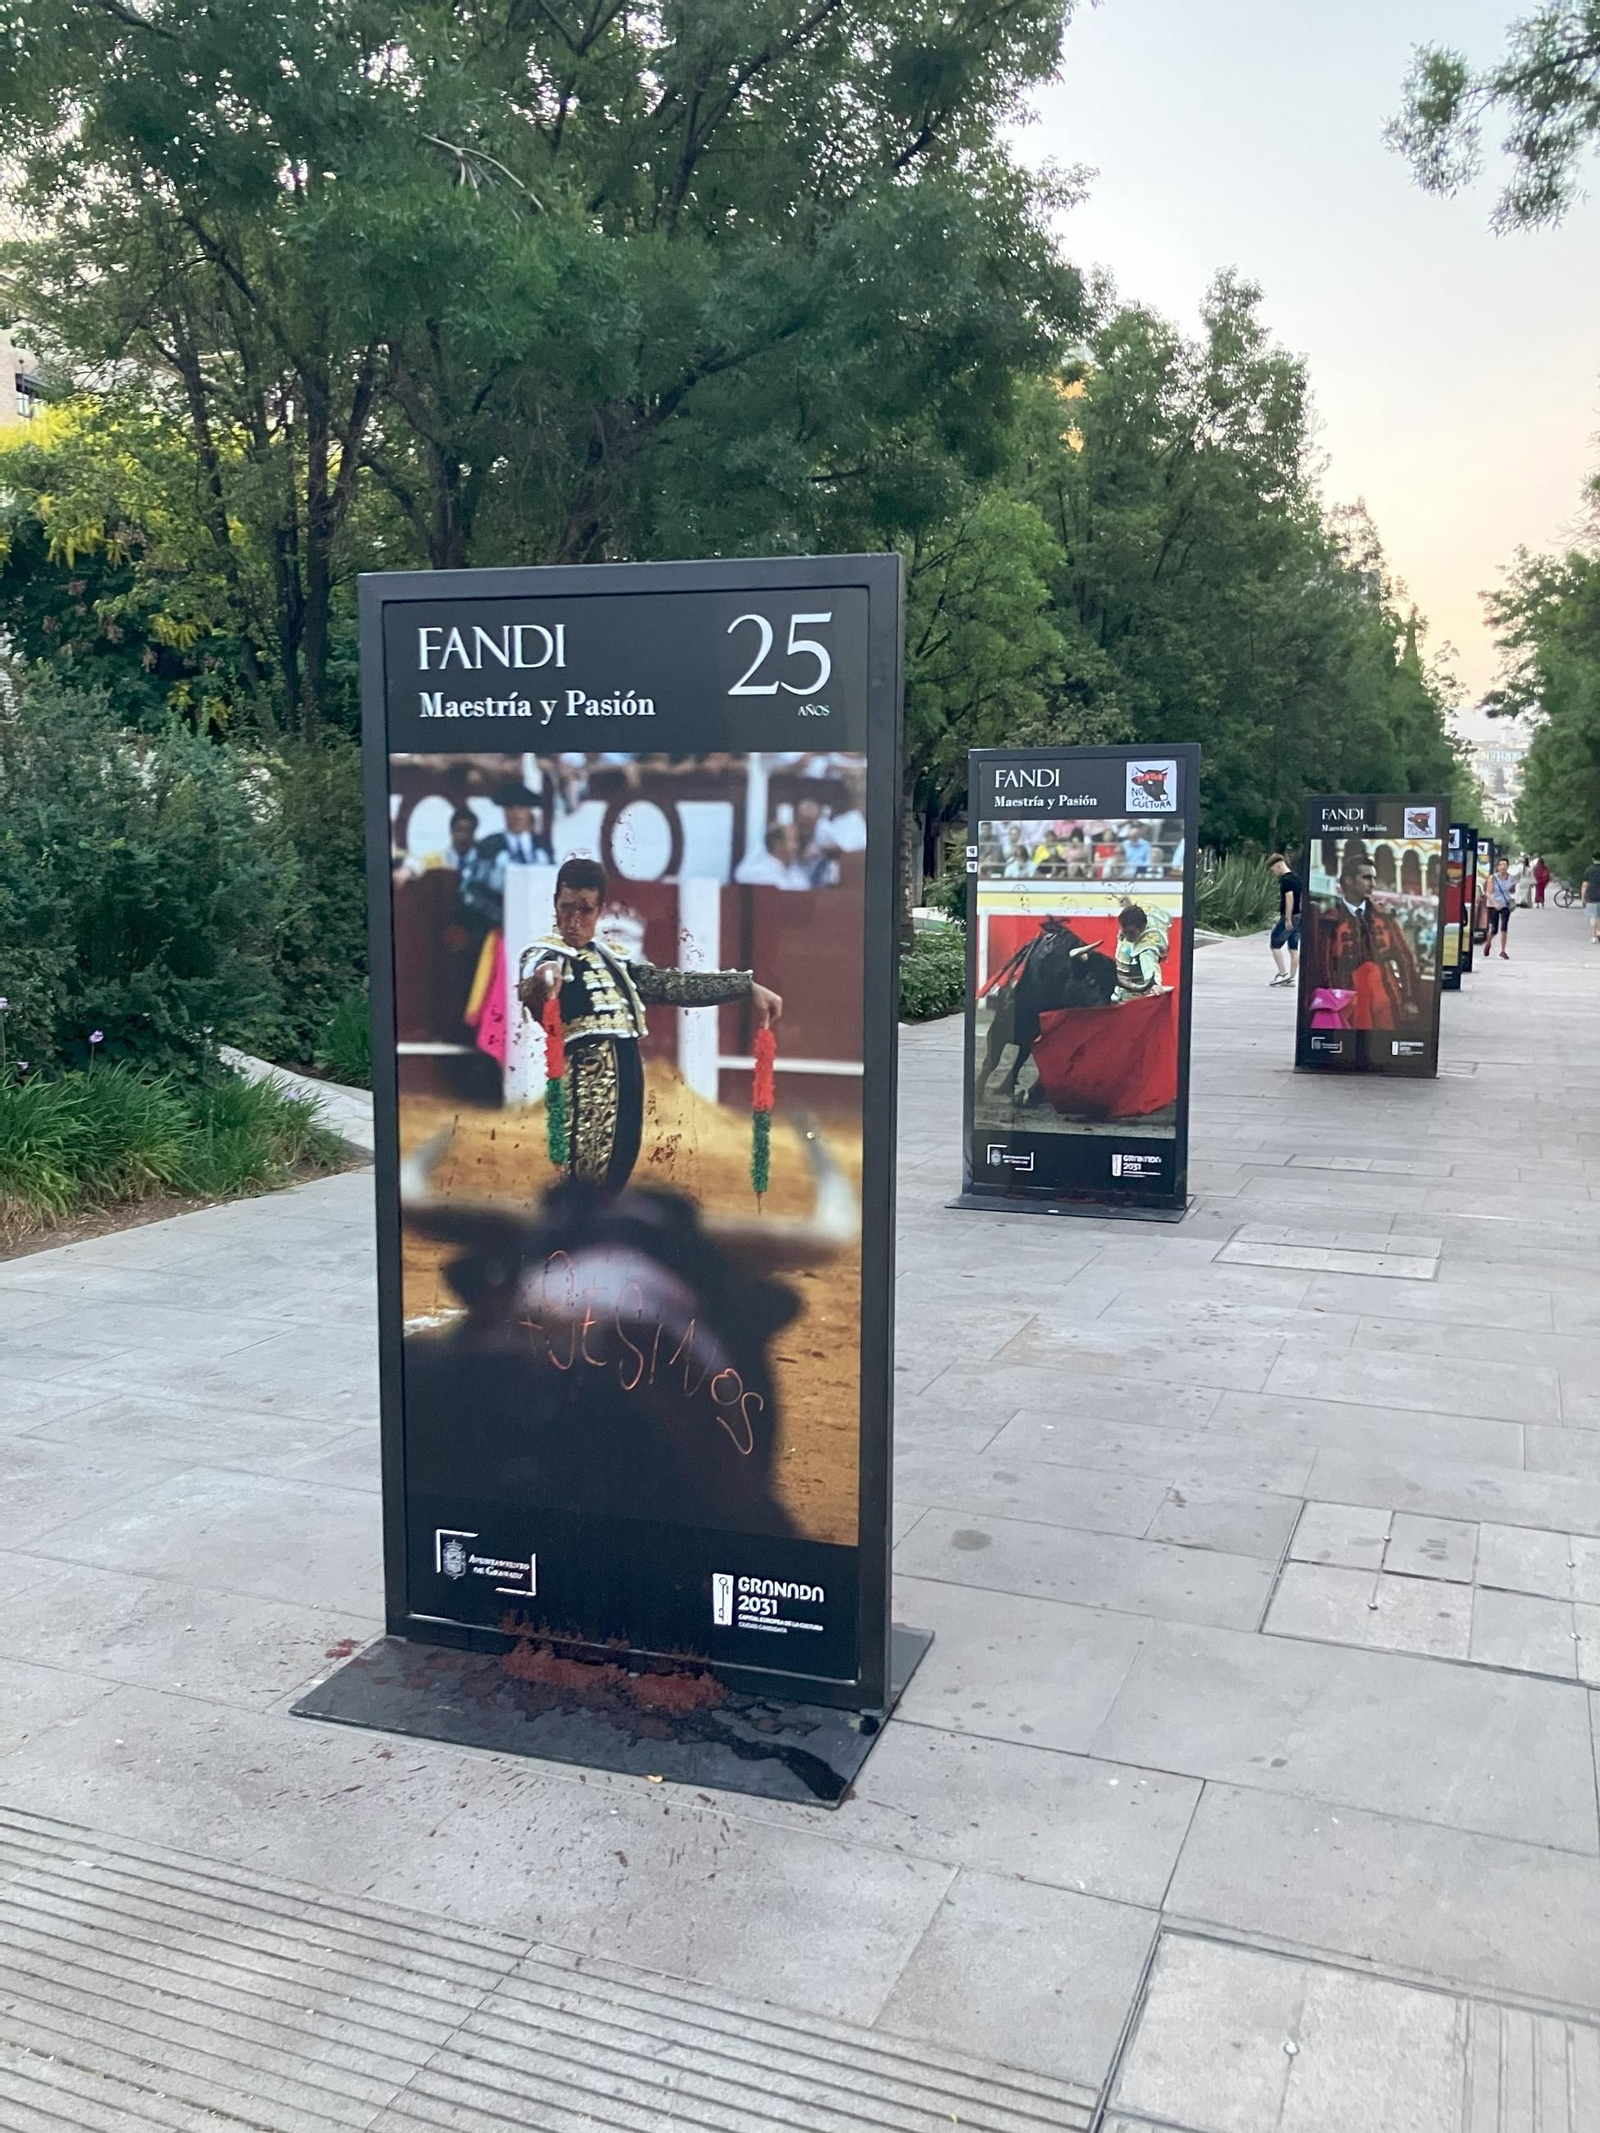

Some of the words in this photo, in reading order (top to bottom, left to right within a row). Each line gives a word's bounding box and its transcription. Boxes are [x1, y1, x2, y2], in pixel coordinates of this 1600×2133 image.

[418, 624, 567, 670] FANDI
[727, 612, 832, 695] 25
[419, 692, 532, 718] Maestría
[541, 697, 558, 725] y
[565, 690, 656, 717] Pasión
[798, 703, 831, 717] AÑOS
[995, 769, 1060, 788] FANDI
[1131, 787, 1143, 797] NO
[994, 795, 1044, 808] Maestría
[1047, 797, 1056, 810] y
[1058, 794, 1098, 807] Pasión
[1132, 797, 1172, 809] CULTURA
[1322, 808, 1364, 820] FANDI
[1123, 1163, 1142, 1171] 2031
[738, 1576, 824, 1603] GRANADA
[737, 1595, 778, 1616] 2031
